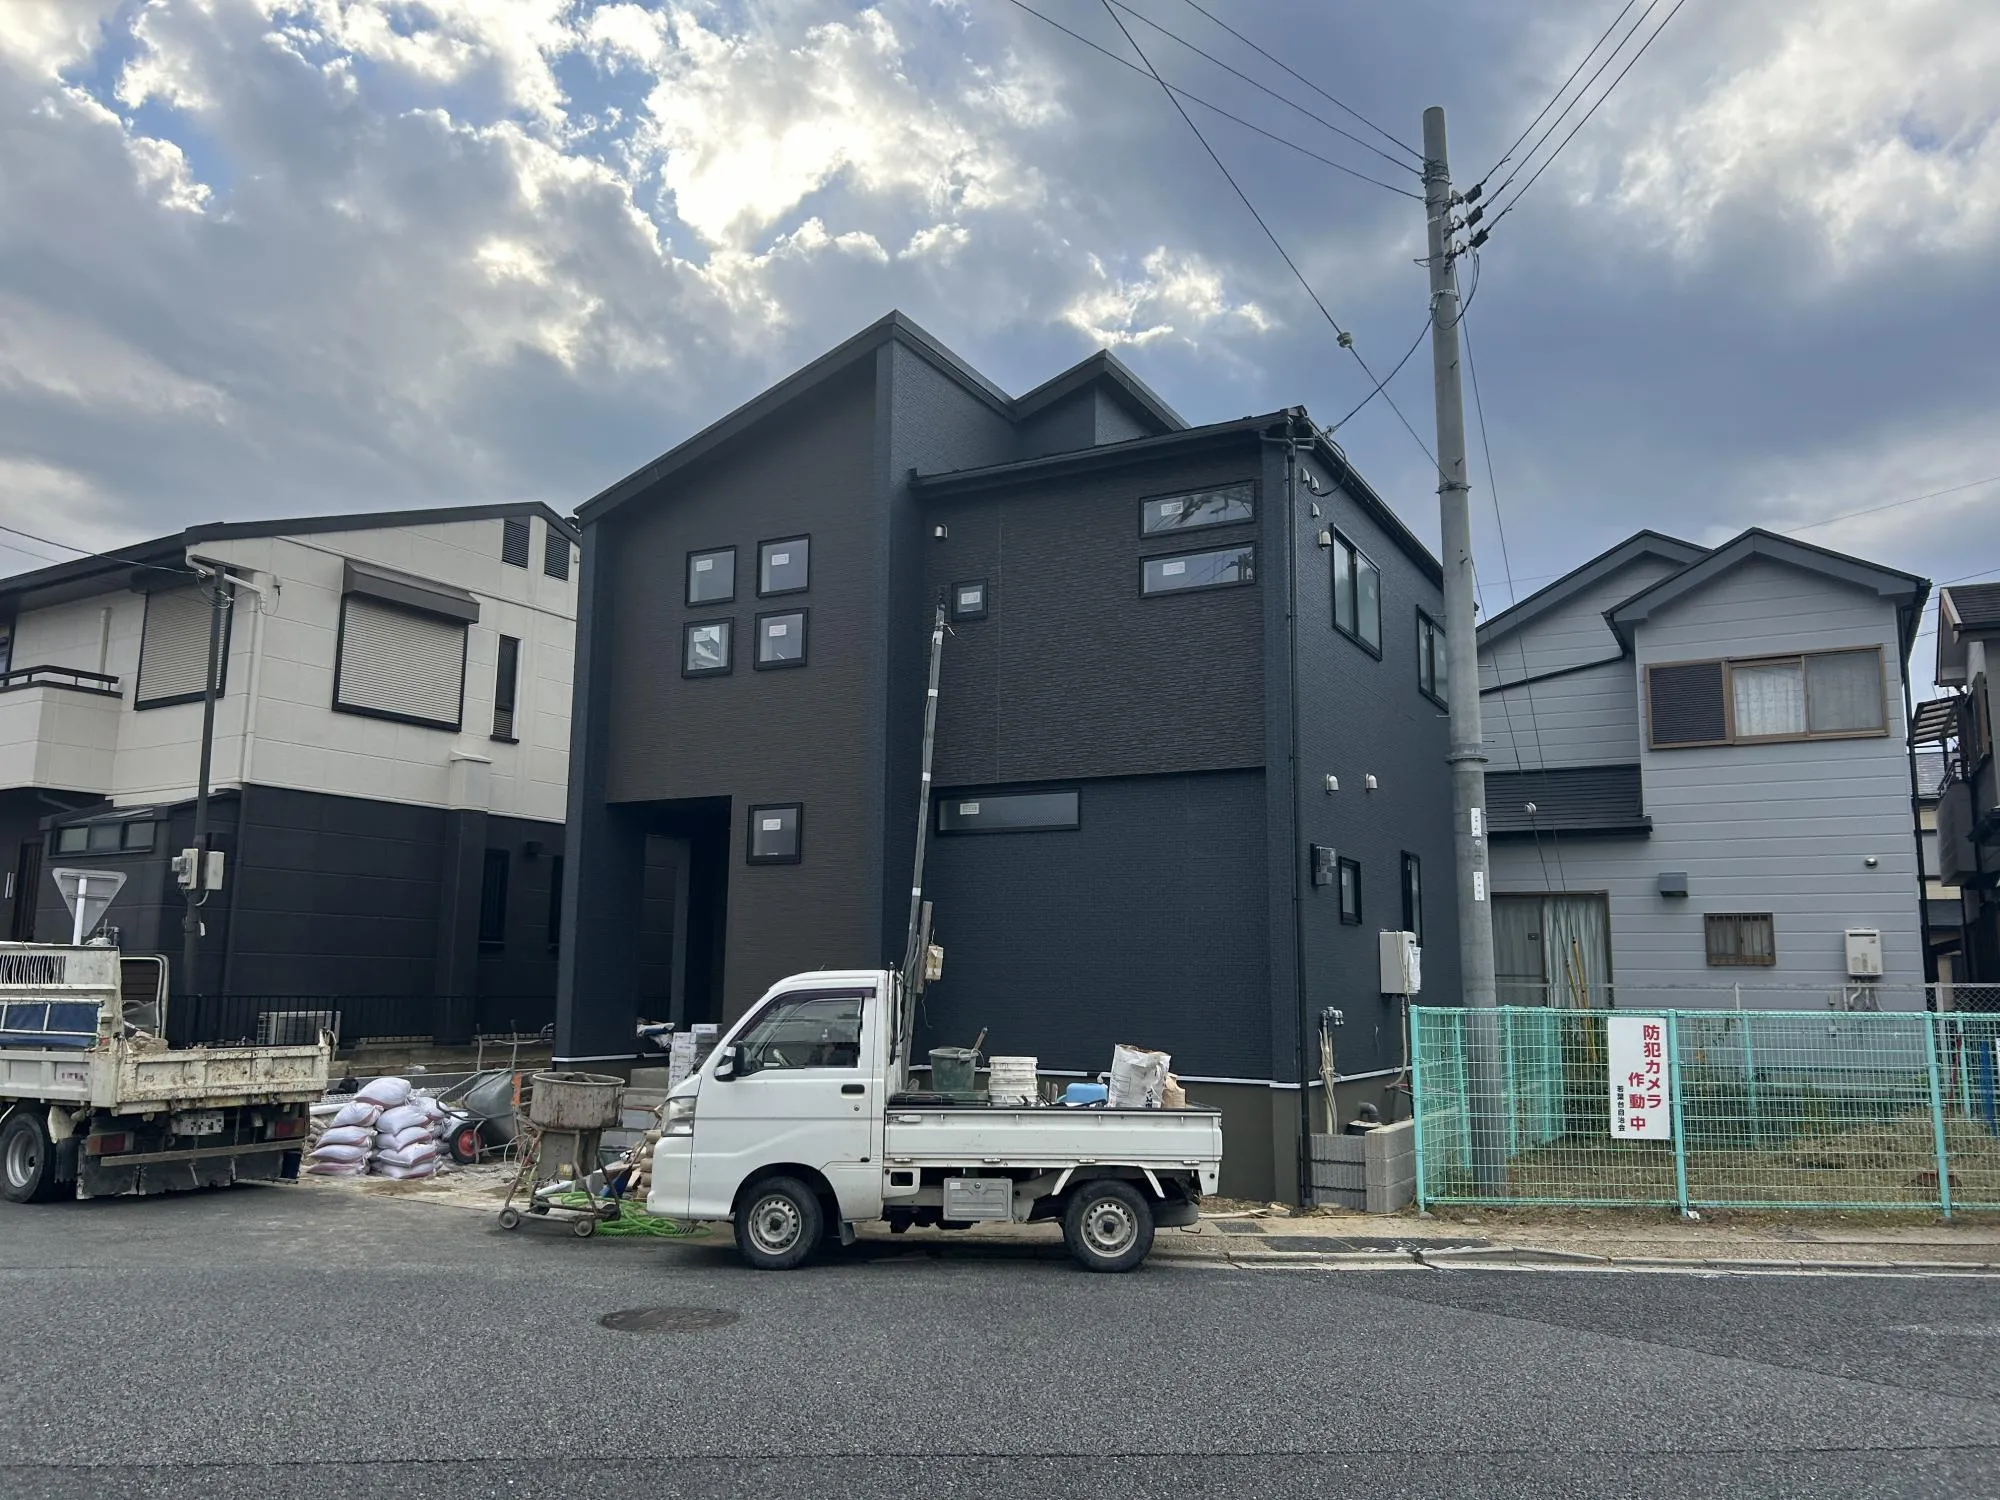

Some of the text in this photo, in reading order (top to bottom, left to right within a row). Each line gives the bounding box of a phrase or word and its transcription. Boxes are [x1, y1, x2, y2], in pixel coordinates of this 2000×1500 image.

[1628, 1072, 1646, 1132] 作動中
[1643, 1024, 1662, 1109] 防犯カメラ
